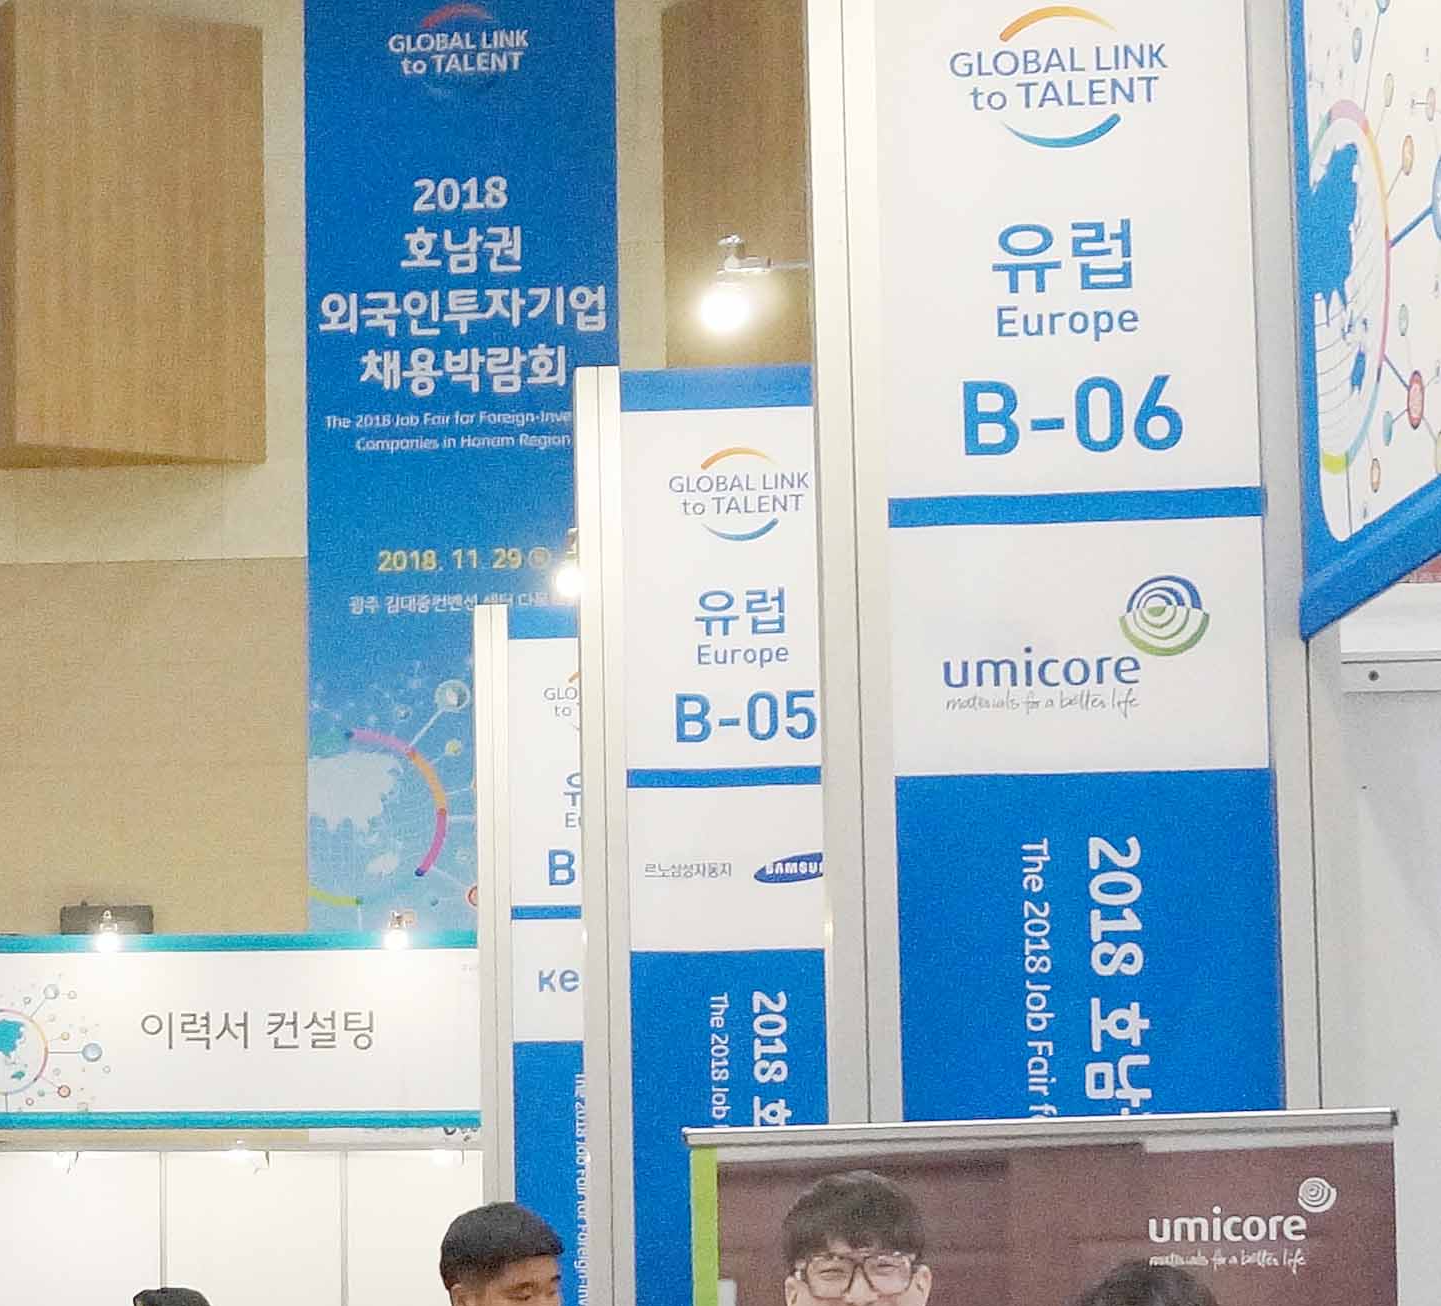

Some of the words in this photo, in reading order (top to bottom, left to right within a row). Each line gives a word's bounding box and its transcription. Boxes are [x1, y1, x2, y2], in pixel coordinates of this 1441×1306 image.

[388, 31, 476, 53] GLOBAL
[480, 29, 529, 50] LINK
[950, 47, 1085, 78] GLOBAL
[1095, 43, 1168, 71] LINK
[401, 56, 427, 75] to
[431, 51, 524, 73] TALENT
[970, 85, 1007, 111] to
[1016, 76, 1159, 109] TALENT
[413, 176, 507, 213] 2018
[400, 225, 522, 274] 호남권
[992, 218, 1133, 294] 유럽
[320, 285, 607, 337] 외국인투자기업
[996, 306, 1139, 342] Europe
[359, 343, 567, 396] 채용박람회
[326, 415, 350, 429] The
[356, 414, 390, 427] 2018
[424, 412, 449, 426] Fair
[962, 374, 1183, 456] B-06
[668, 474, 755, 493] GLOBAL
[761, 472, 810, 489] LINK
[682, 500, 706, 516] to
[712, 495, 804, 515] TALENT
[694, 587, 788, 636] 유럽
[697, 644, 789, 668] Europe
[943, 646, 1141, 688] umicore
[555, 705, 572, 717] to
[675, 690, 818, 744] B-05
[1111, 688, 1139, 718] life
[1021, 838, 1050, 893] The
[1088, 836, 1143, 977] 2018
[1023, 900, 1052, 974] 2018
[710, 992, 729, 1028] The
[1025, 979, 1055, 1032] Job
[141, 1010, 251, 1051] 이력서
[266, 1010, 376, 1051] 컨설팅
[752, 991, 788, 1083] 2018
[711, 1034, 729, 1081] 2018
[1027, 1041, 1057, 1096] Fair
[1085, 998, 1151, 1116] 호남
[711, 1088, 731, 1120] Job
[1149, 1206, 1307, 1243] umicore
